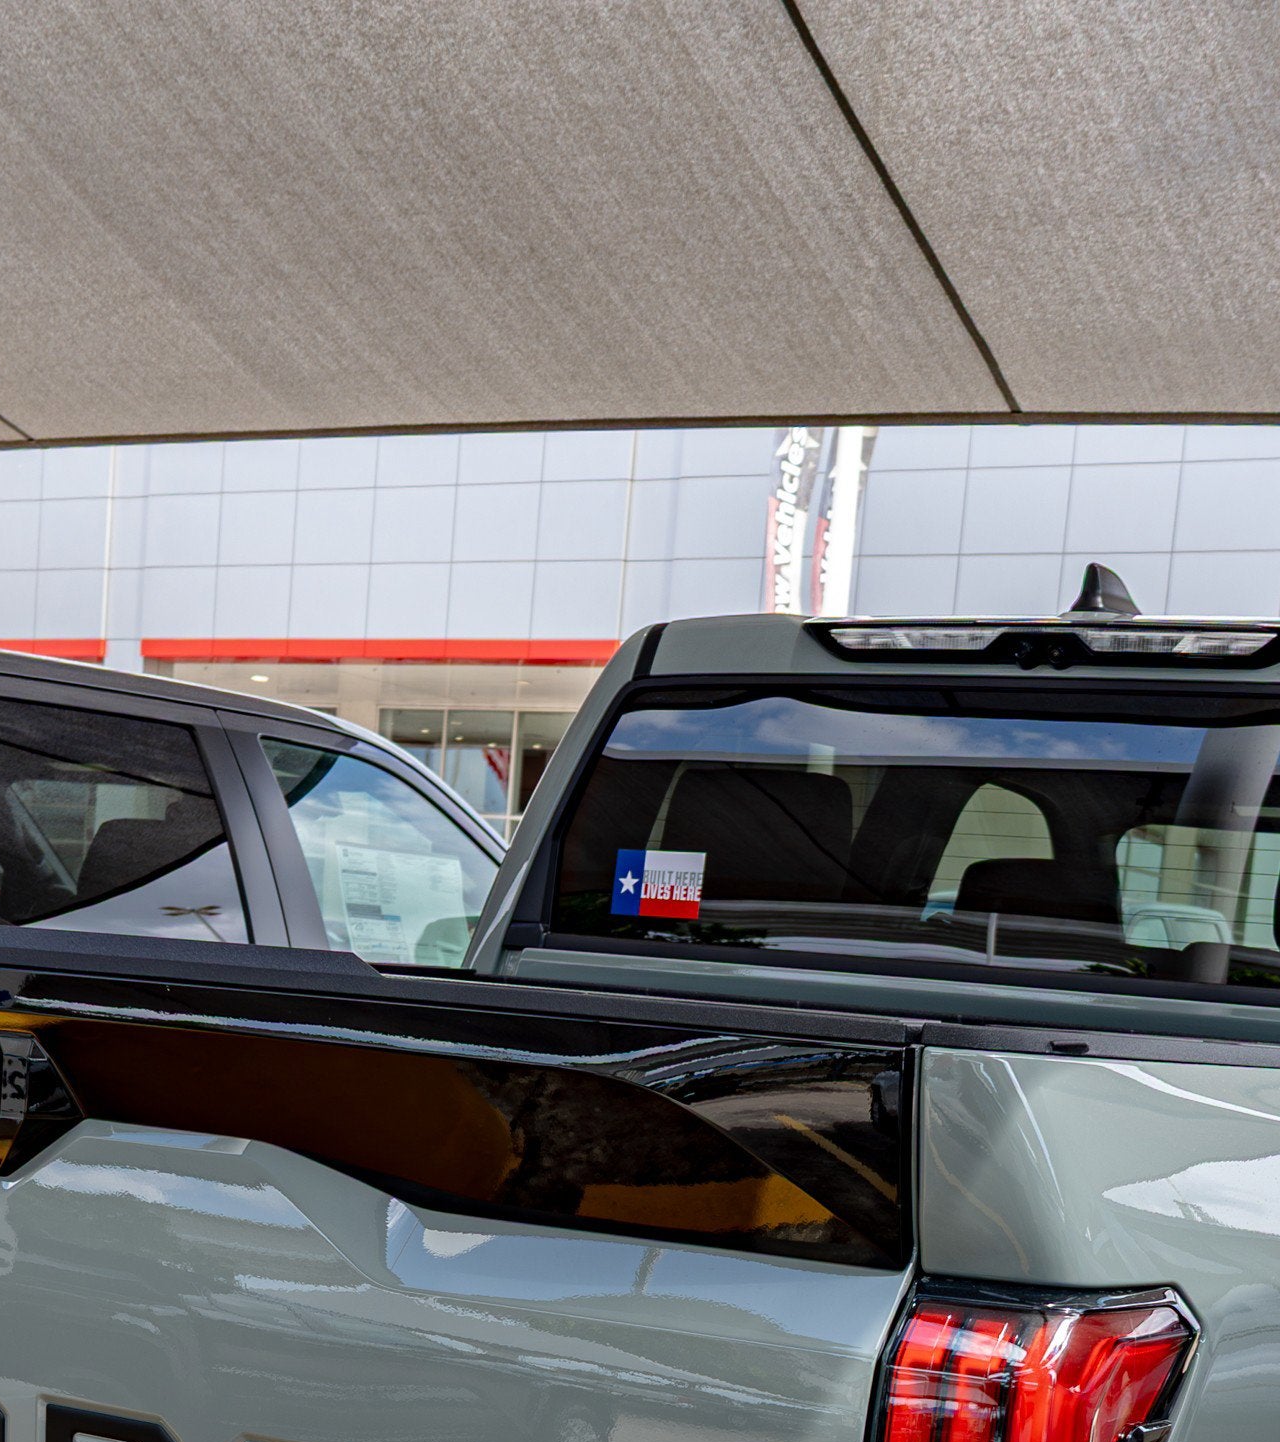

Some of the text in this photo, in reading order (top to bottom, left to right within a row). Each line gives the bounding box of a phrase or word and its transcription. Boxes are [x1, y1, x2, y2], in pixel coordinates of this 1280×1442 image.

[643, 869, 704, 887] BUILT HERE
[640, 883, 702, 902] LIVES HERE
